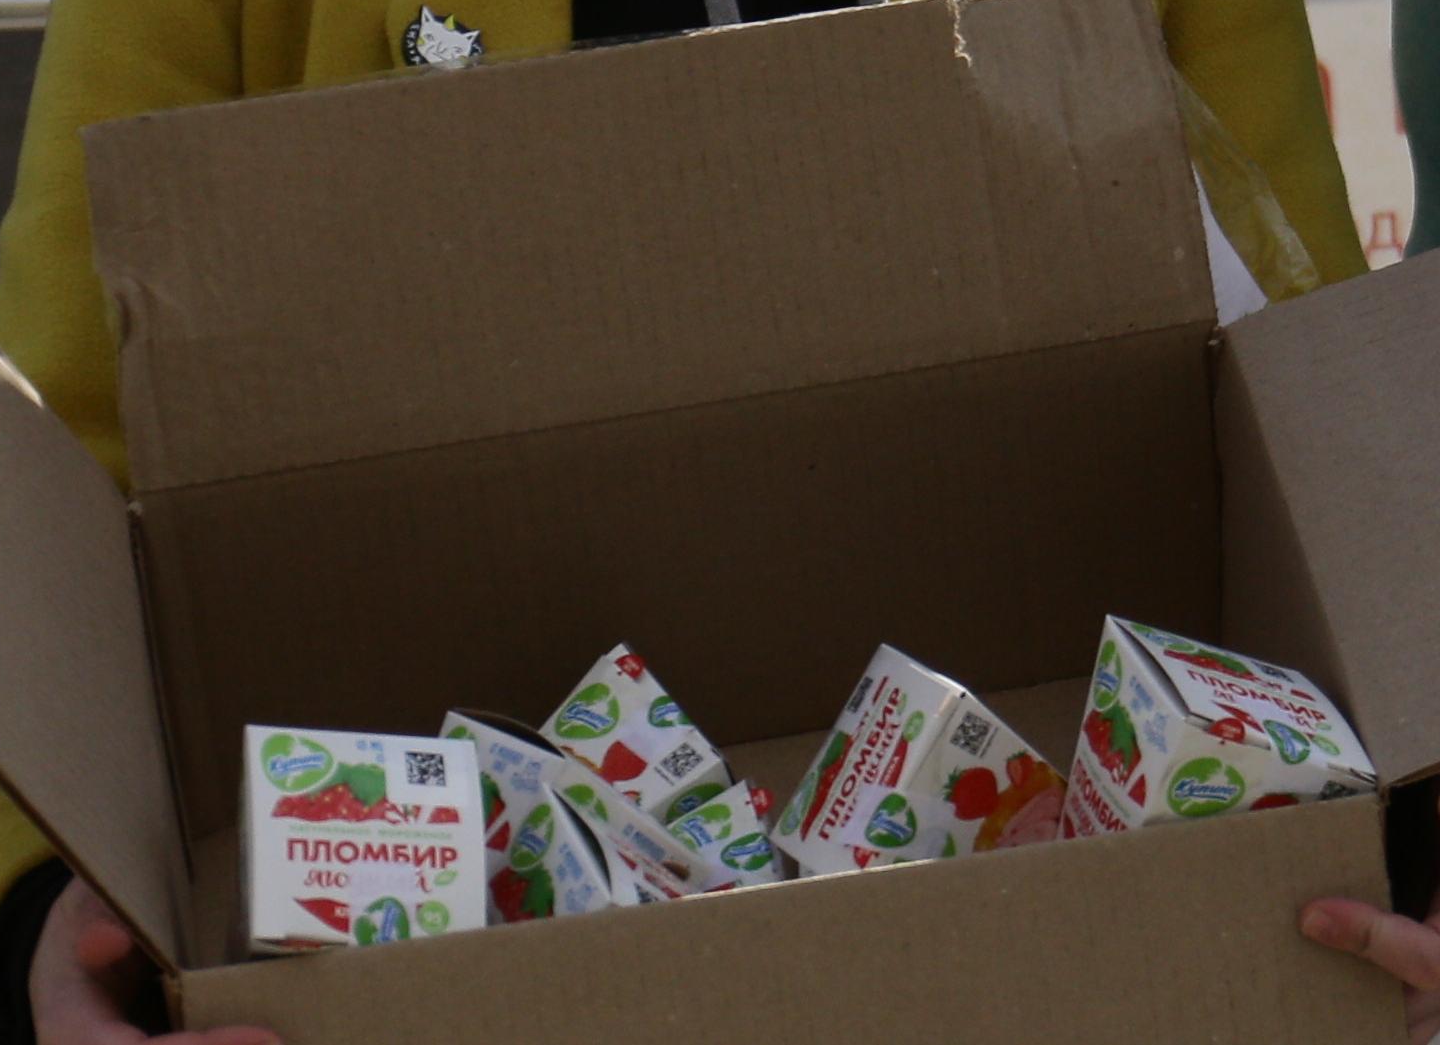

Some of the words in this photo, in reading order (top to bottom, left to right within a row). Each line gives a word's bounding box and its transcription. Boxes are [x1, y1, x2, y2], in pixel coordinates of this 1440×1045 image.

[1186, 668, 1328, 723] ПЛОМБИР
[817, 685, 901, 842] ПЛОМБИР
[286, 837, 458, 869] ПЛОМБИР
